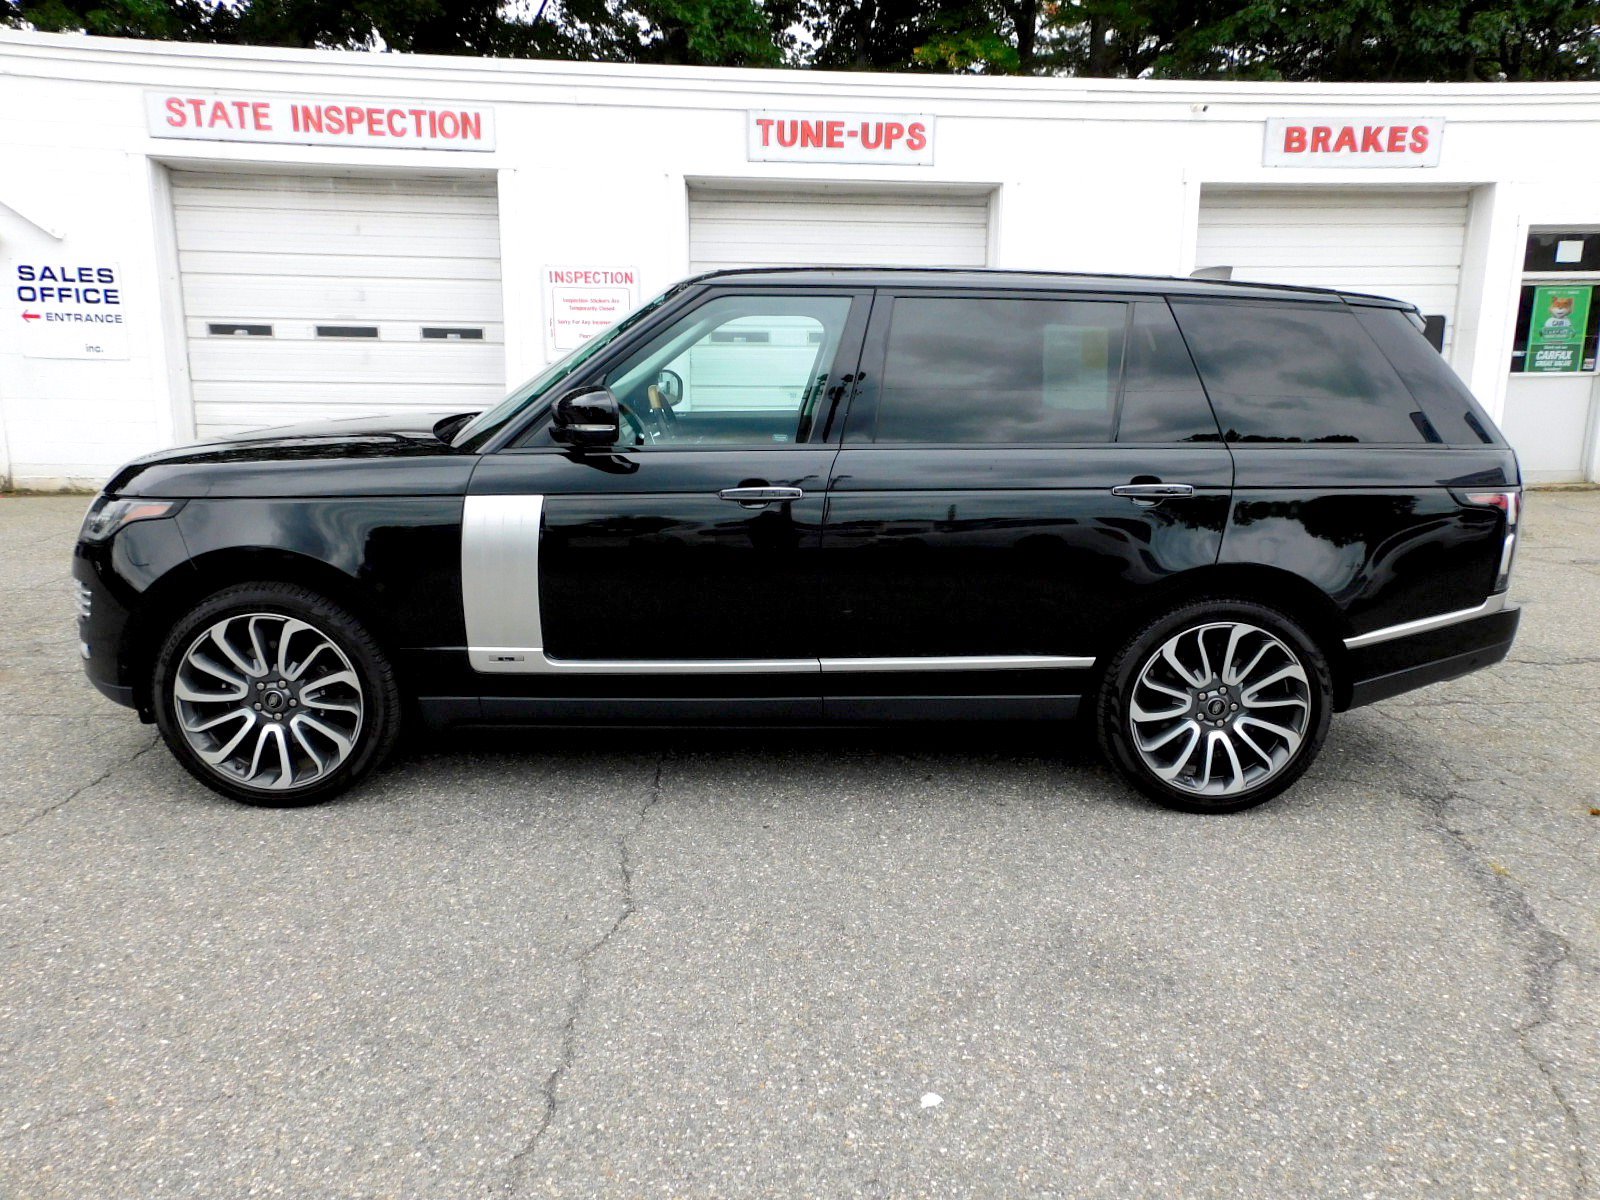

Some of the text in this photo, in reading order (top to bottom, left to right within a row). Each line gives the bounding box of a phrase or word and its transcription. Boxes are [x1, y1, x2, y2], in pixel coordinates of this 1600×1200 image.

[165, 98, 481, 139] STATE INSPECTION
[757, 119, 927, 151] TUNE-UPS
[1284, 125, 1429, 153] BRAKES
[17, 264, 115, 284] SALES
[548, 270, 634, 285] INSPECTION
[17, 285, 120, 305] OFFICE
[45, 311, 124, 324] ENTRANCE
[1535, 350, 1574, 361] CARFAX
